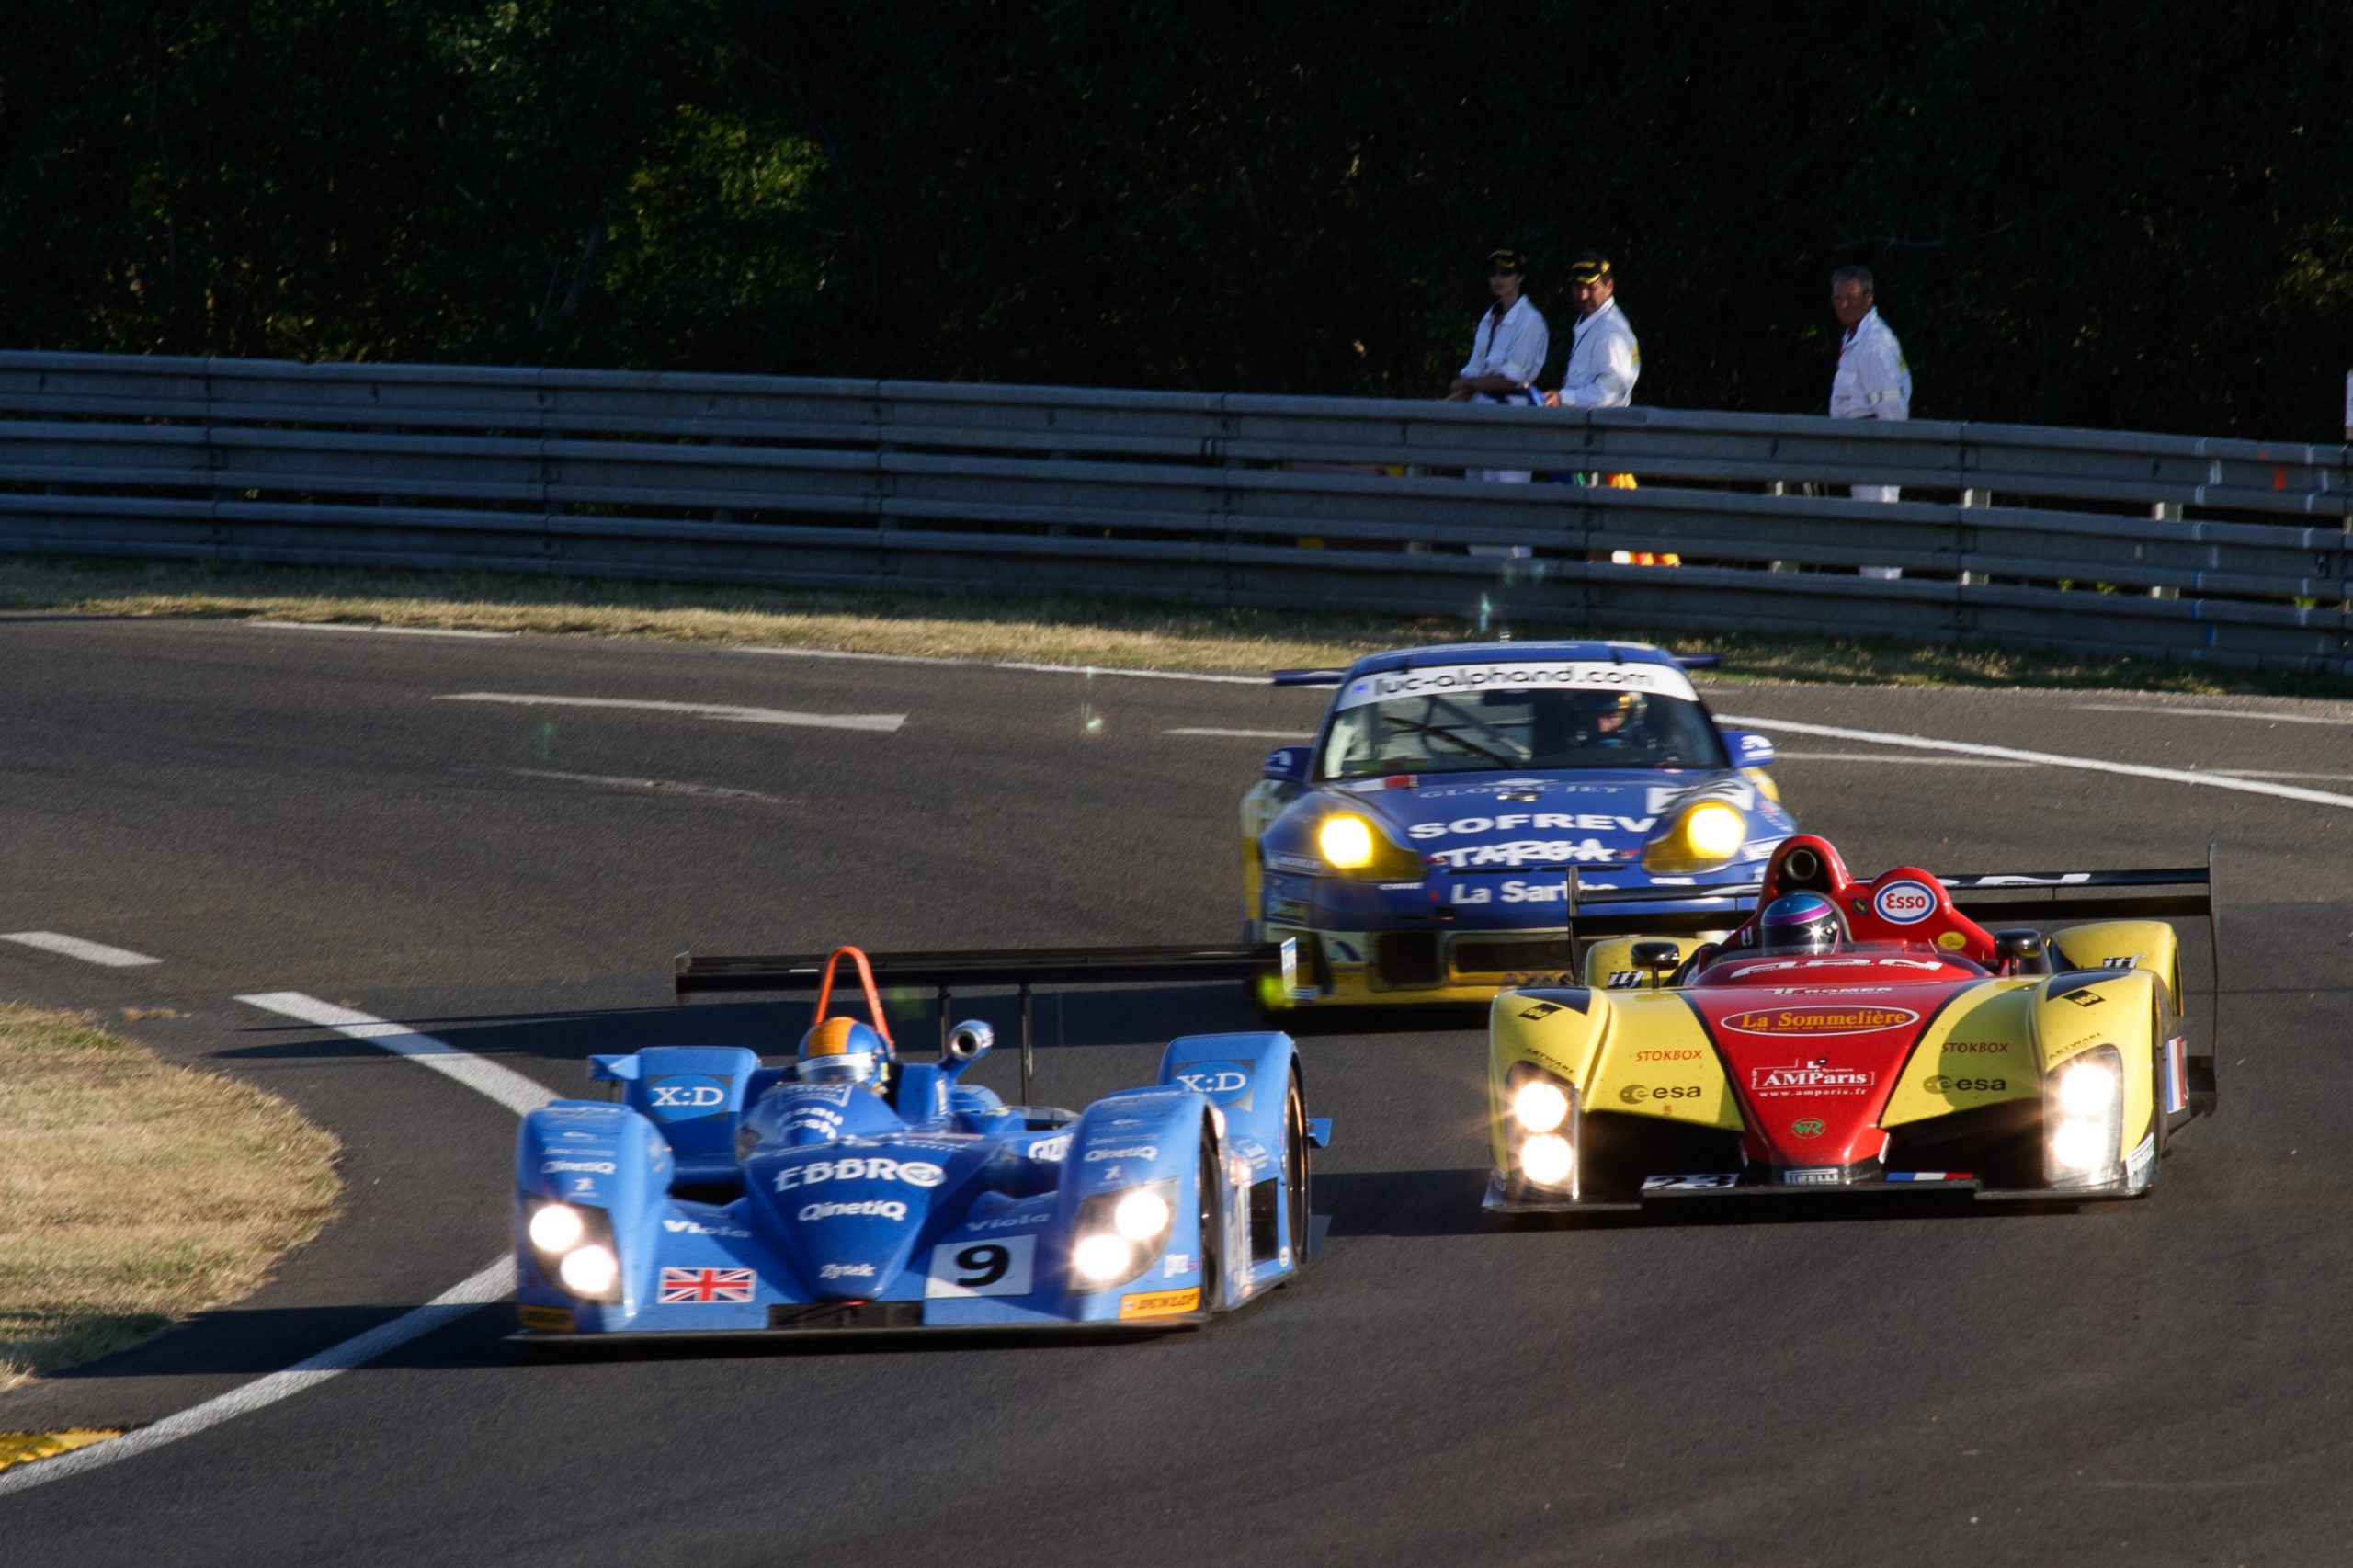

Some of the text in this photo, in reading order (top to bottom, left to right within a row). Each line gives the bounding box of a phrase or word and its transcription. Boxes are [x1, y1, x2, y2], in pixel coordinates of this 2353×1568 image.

[1375, 666, 1653, 696] luc-alphand.com
[1408, 813, 1658, 839] SOFREV
[1450, 884, 1492, 904] La
[1741, 1008, 1908, 1028] La Sommelière
[1635, 1050, 1703, 1062] STOKBOX
[1941, 1042, 2009, 1053] STOKBOX
[1762, 1072, 1868, 1087] AMParis
[1955, 1078, 2006, 1092] esa
[1652, 1085, 1702, 1099] esa
[798, 1200, 908, 1221] QinetiQ
[955, 1244, 1009, 1287] 9
